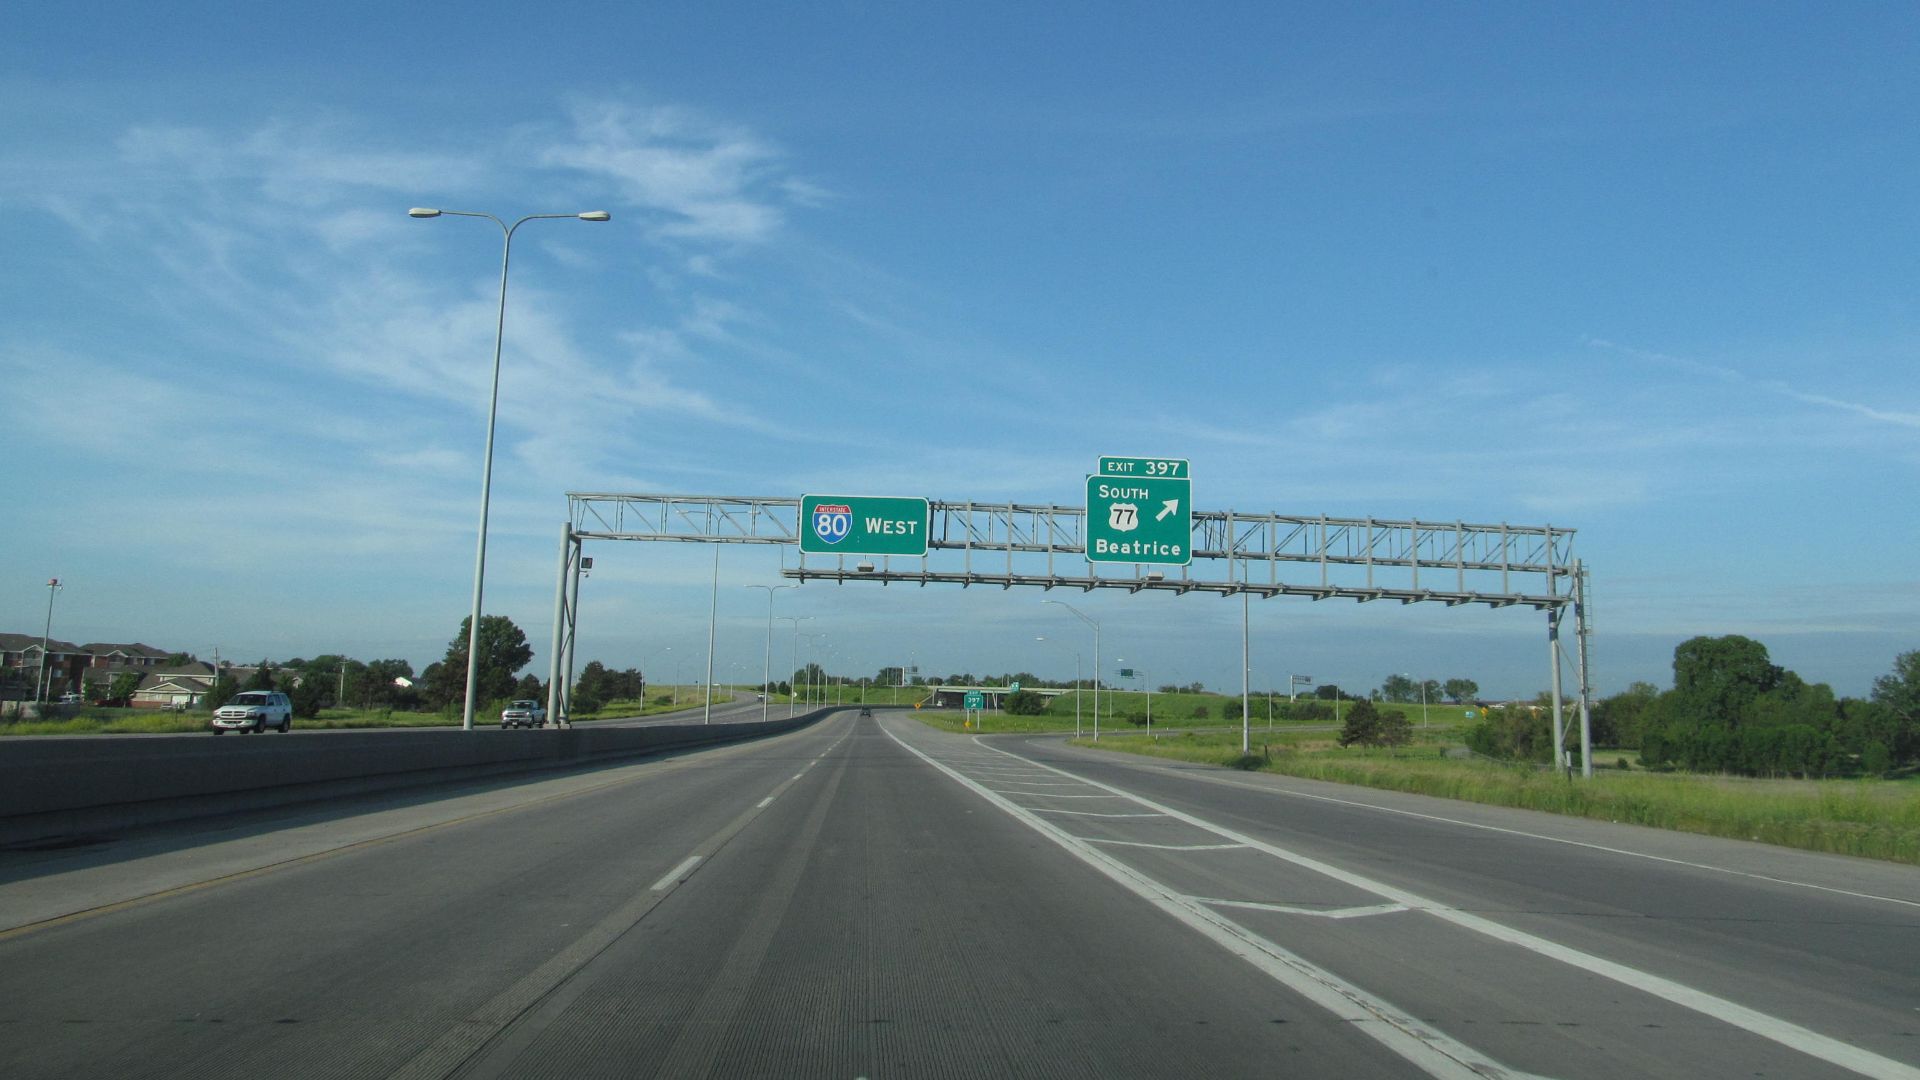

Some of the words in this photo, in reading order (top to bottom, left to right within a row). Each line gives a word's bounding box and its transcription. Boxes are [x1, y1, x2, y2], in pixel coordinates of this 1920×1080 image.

[1107, 462, 1135, 472] EXIT
[1145, 461, 1180, 476] 397
[1098, 485, 1149, 500] SOUTH
[817, 514, 848, 536] 80
[1112, 508, 1135, 525] 77
[865, 517, 918, 535] WEST
[1096, 538, 1181, 556] Beatrice
